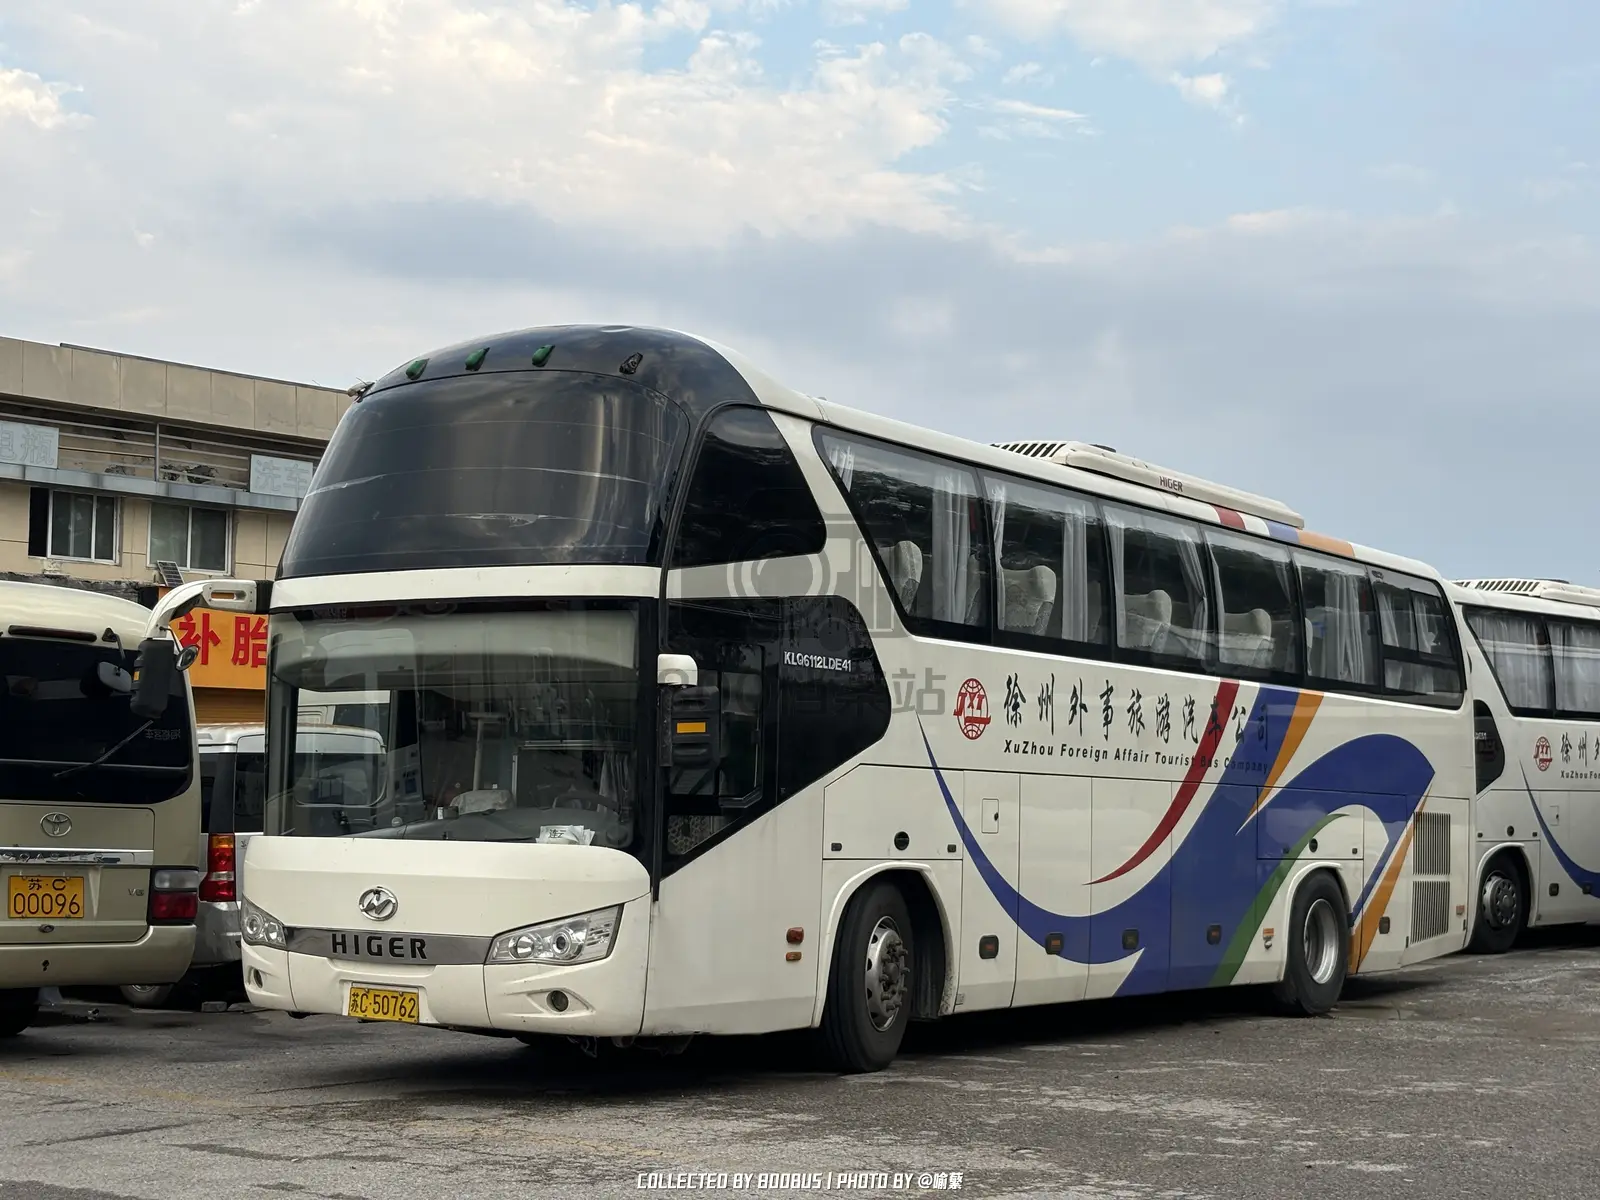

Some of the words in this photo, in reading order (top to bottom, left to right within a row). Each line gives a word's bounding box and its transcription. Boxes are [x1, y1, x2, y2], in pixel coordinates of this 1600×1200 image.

[1159, 475, 1183, 493] HIGER
[178, 612, 268, 669] 补胎
[783, 651, 852, 672] KLQ6112LDE41
[1003, 739, 1054, 756] XuZhou
[1060, 743, 1108, 763] Foreign
[1114, 747, 1149, 764] Affair
[1154, 751, 1195, 768] Tourist
[1199, 755, 1219, 769] Bus
[1223, 756, 1269, 776] Company
[13, 892, 81, 916] 00096
[331, 932, 428, 960] HIGER
